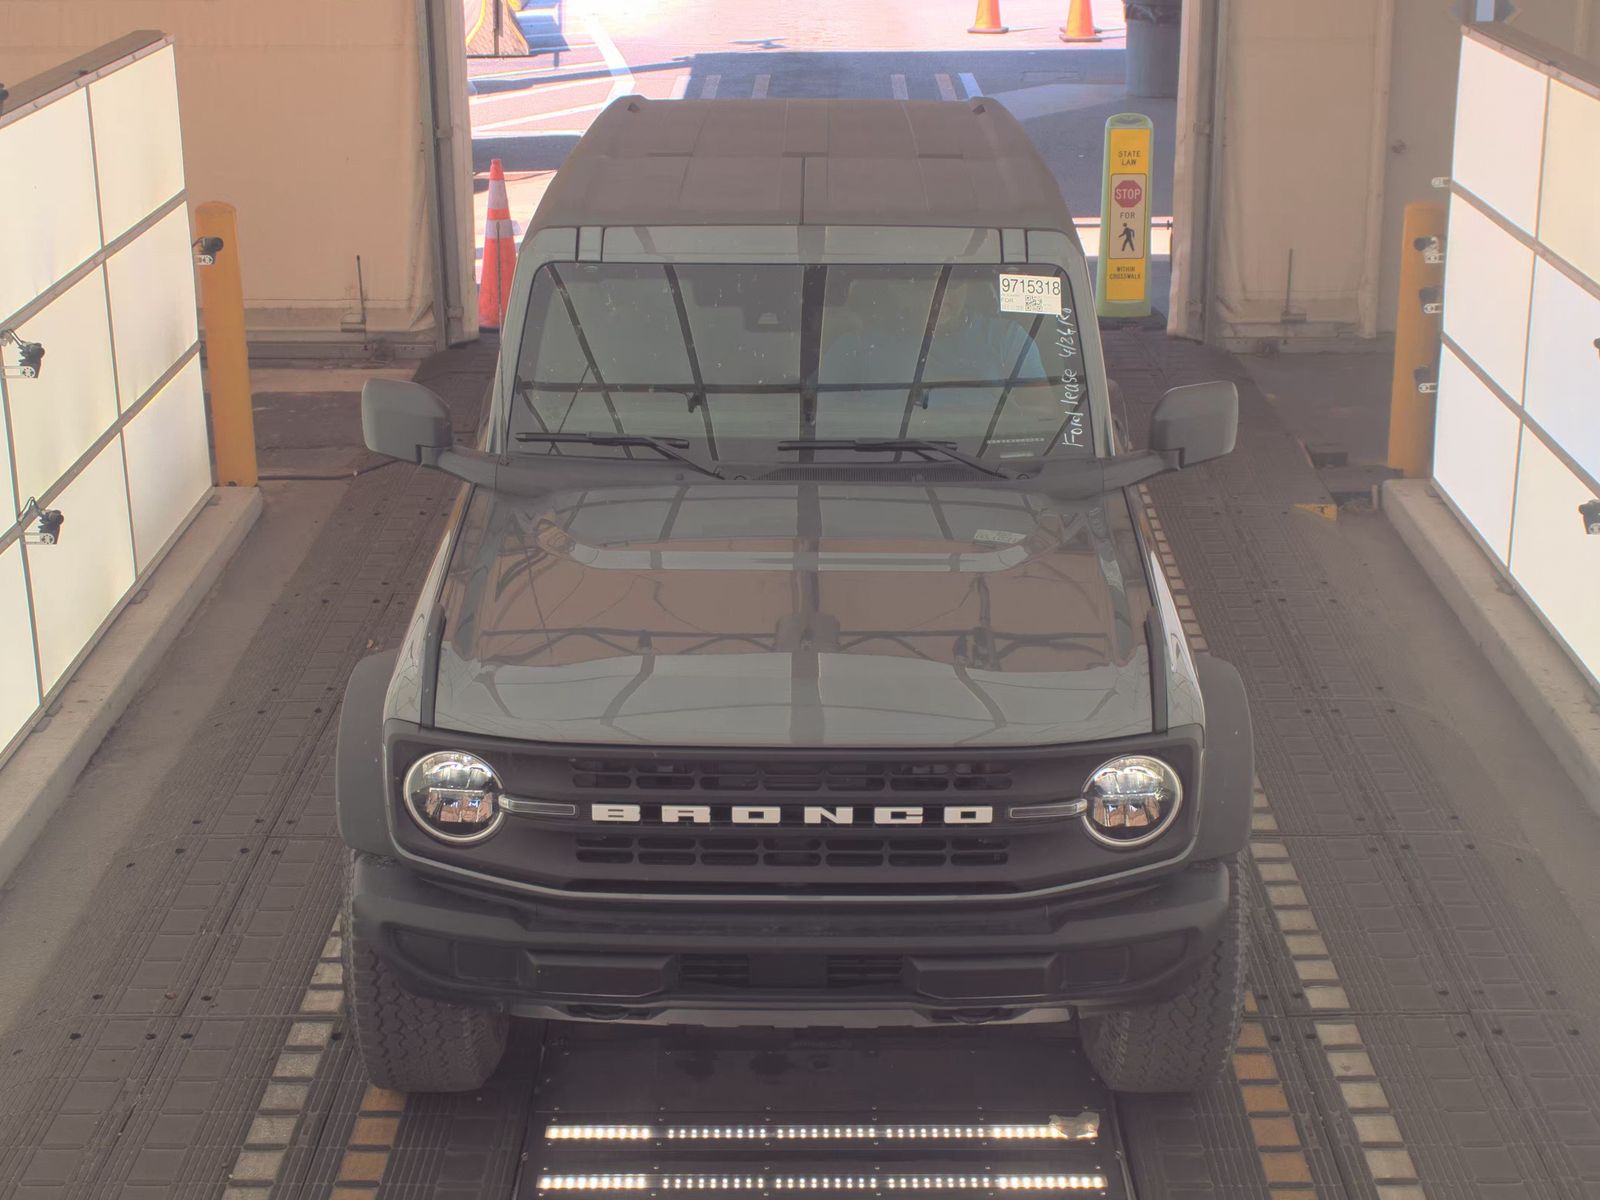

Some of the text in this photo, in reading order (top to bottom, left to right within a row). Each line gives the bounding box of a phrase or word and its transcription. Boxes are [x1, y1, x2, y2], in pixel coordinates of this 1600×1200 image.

[1118, 150, 1141, 158] STATE
[1115, 188, 1141, 200] STOP
[1001, 277, 1061, 296] 9715318
[1060, 368, 1079, 405] lease
[1062, 411, 1084, 448] Ford
[591, 803, 994, 824] BRONCO
